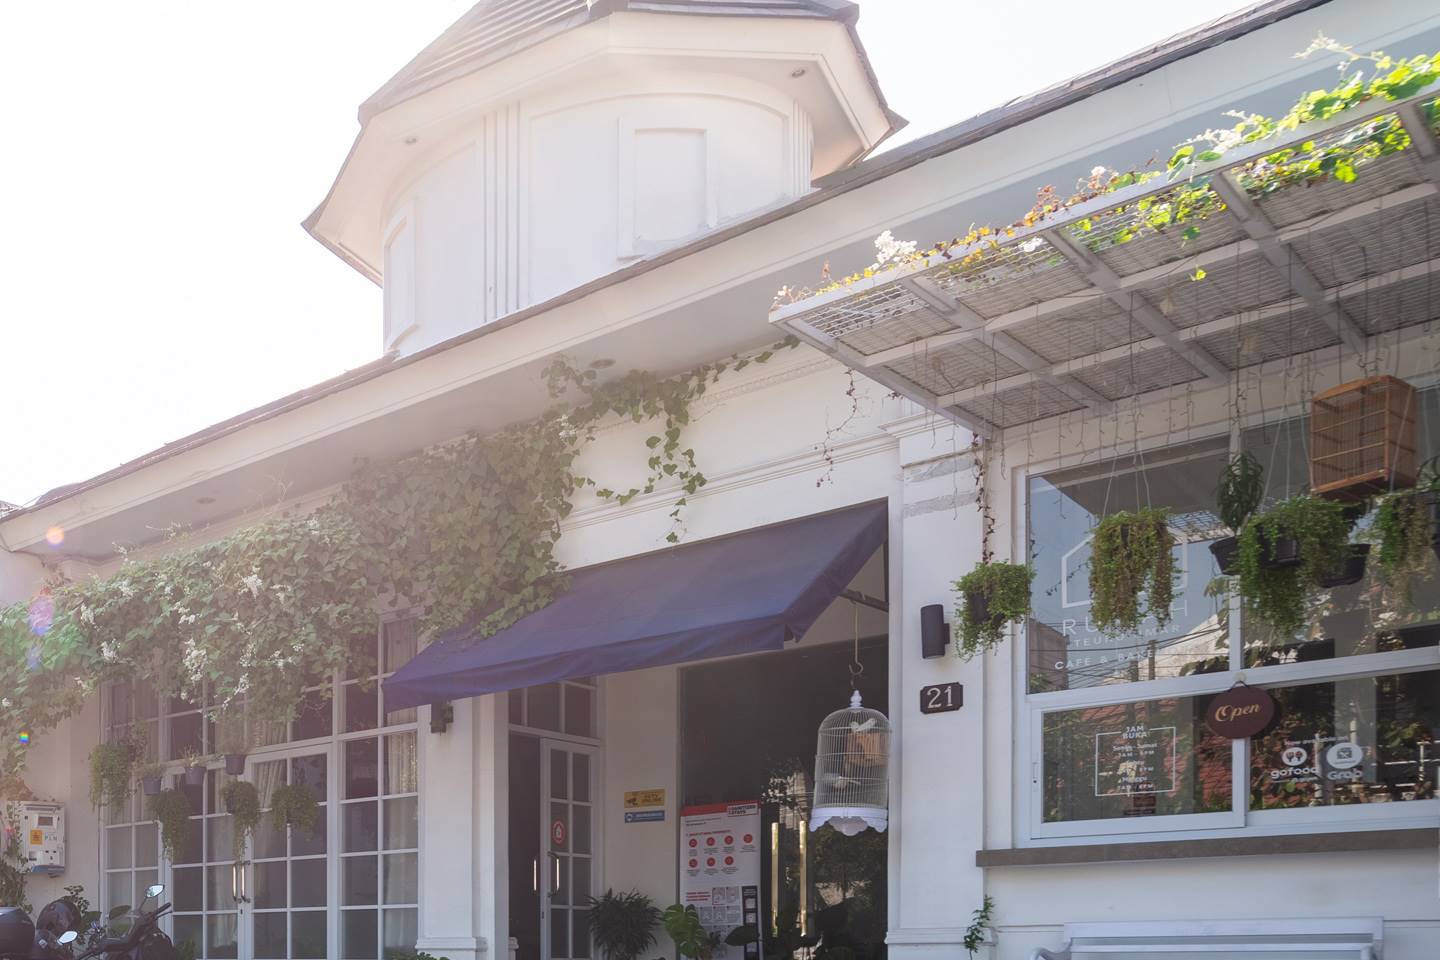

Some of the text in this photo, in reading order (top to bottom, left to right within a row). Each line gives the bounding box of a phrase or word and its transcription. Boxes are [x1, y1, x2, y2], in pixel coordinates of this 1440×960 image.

[1062, 600, 1187, 636] RUH
[1054, 656, 1092, 670] CAFE
[926, 685, 953, 709] 21
[1215, 703, 1260, 722] Open
[1122, 731, 1148, 739] BUKA
[1126, 725, 1144, 733] JAM
[1270, 766, 1320, 780] gofood
[1328, 769, 1363, 780] Grab
